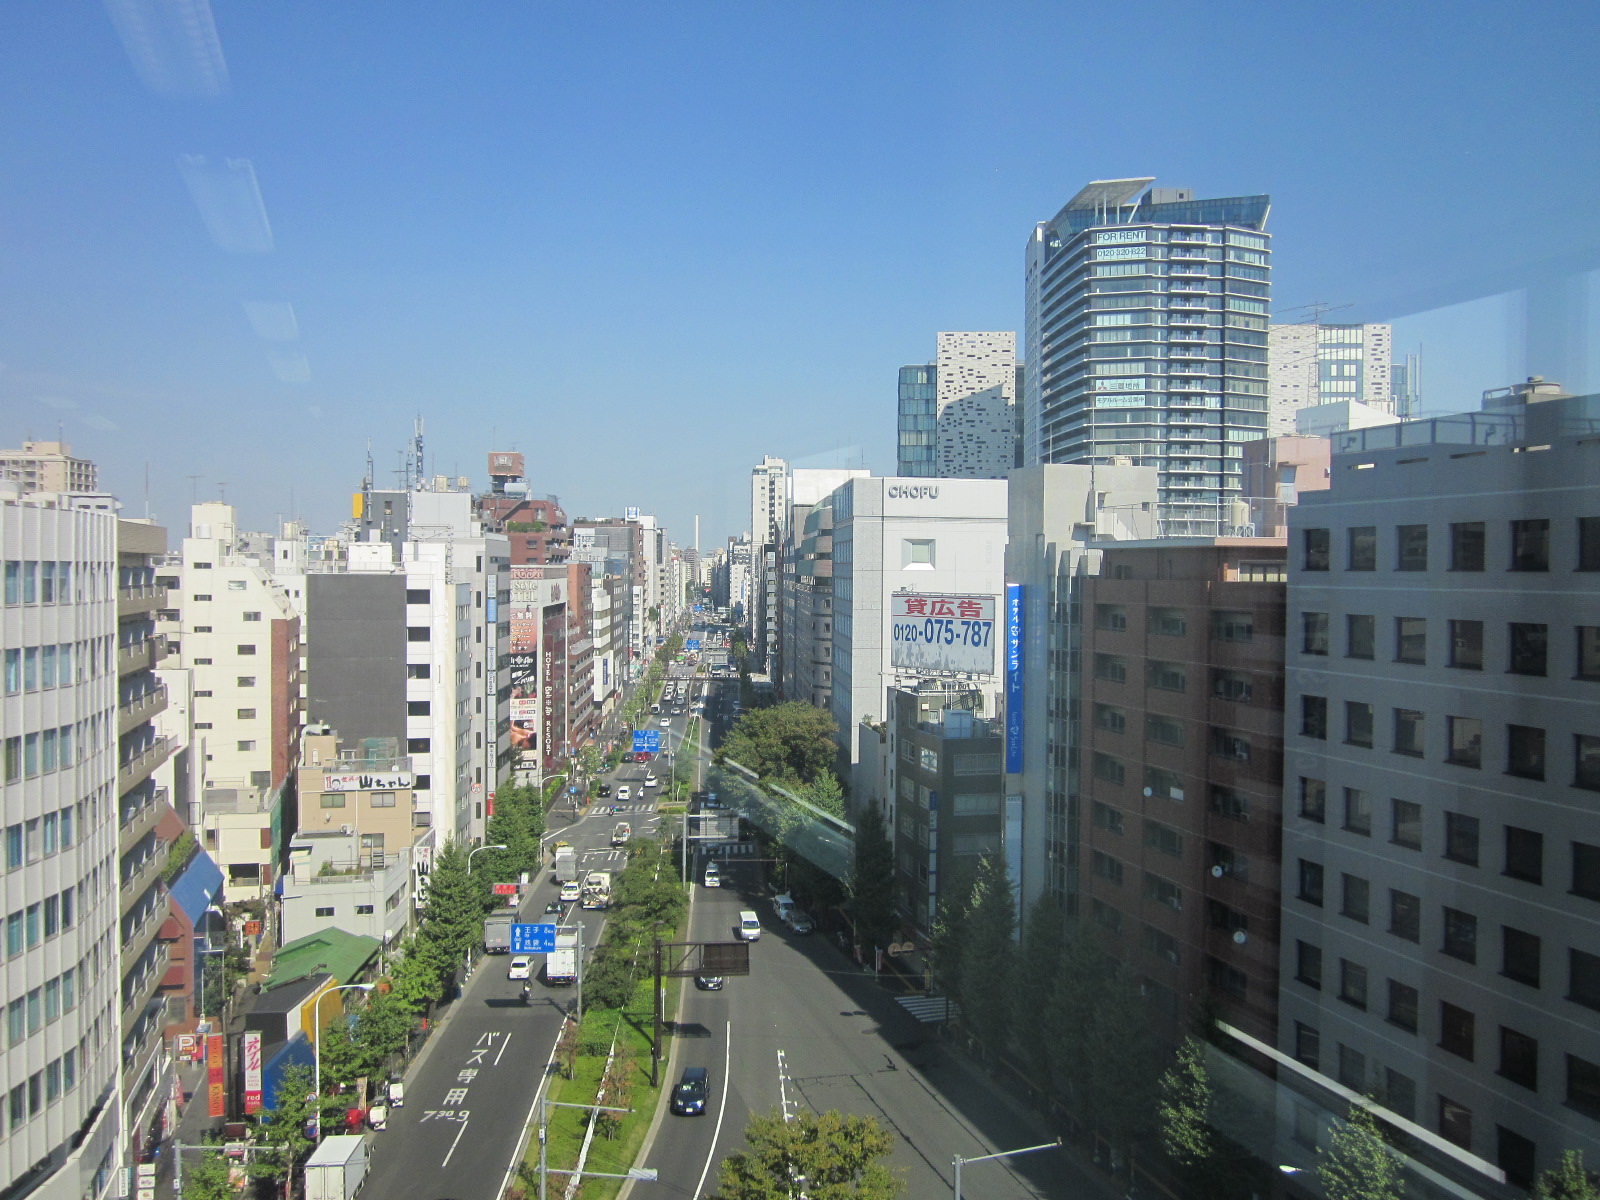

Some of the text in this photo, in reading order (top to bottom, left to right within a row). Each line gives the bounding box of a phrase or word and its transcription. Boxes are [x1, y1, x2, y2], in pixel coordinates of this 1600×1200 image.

[1097, 231, 1145, 241] FOR RENT
[888, 485, 940, 499] CHOFU
[904, 597, 983, 618] 貸広告
[893, 617, 993, 648] 0120-075-787
[1011, 598, 1020, 693] ホテル サンライト
[245, 1036, 262, 1071] ネイル
[442, 1032, 501, 1105] バス専用
